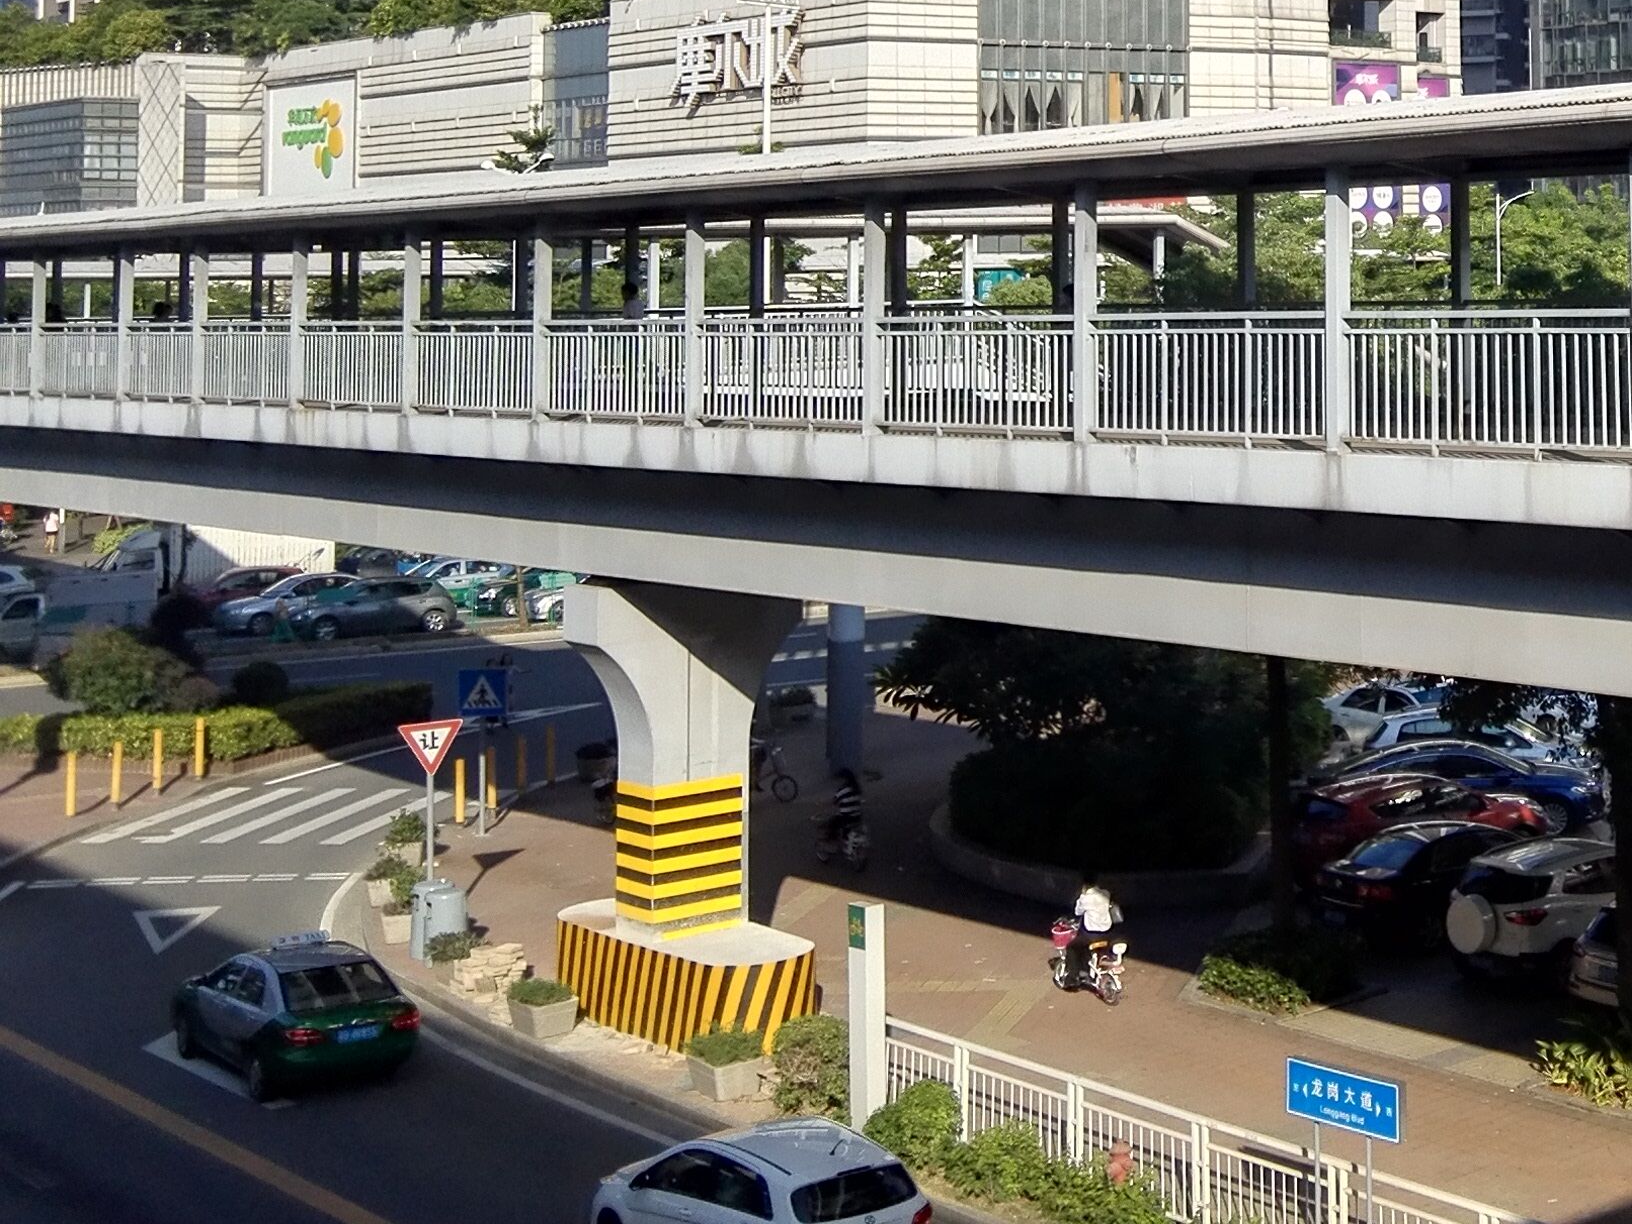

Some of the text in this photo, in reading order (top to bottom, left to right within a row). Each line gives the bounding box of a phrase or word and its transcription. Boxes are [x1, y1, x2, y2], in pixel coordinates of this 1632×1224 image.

[419, 731, 439, 750] 让
[1311, 1078, 1373, 1112] 龙岗大道
